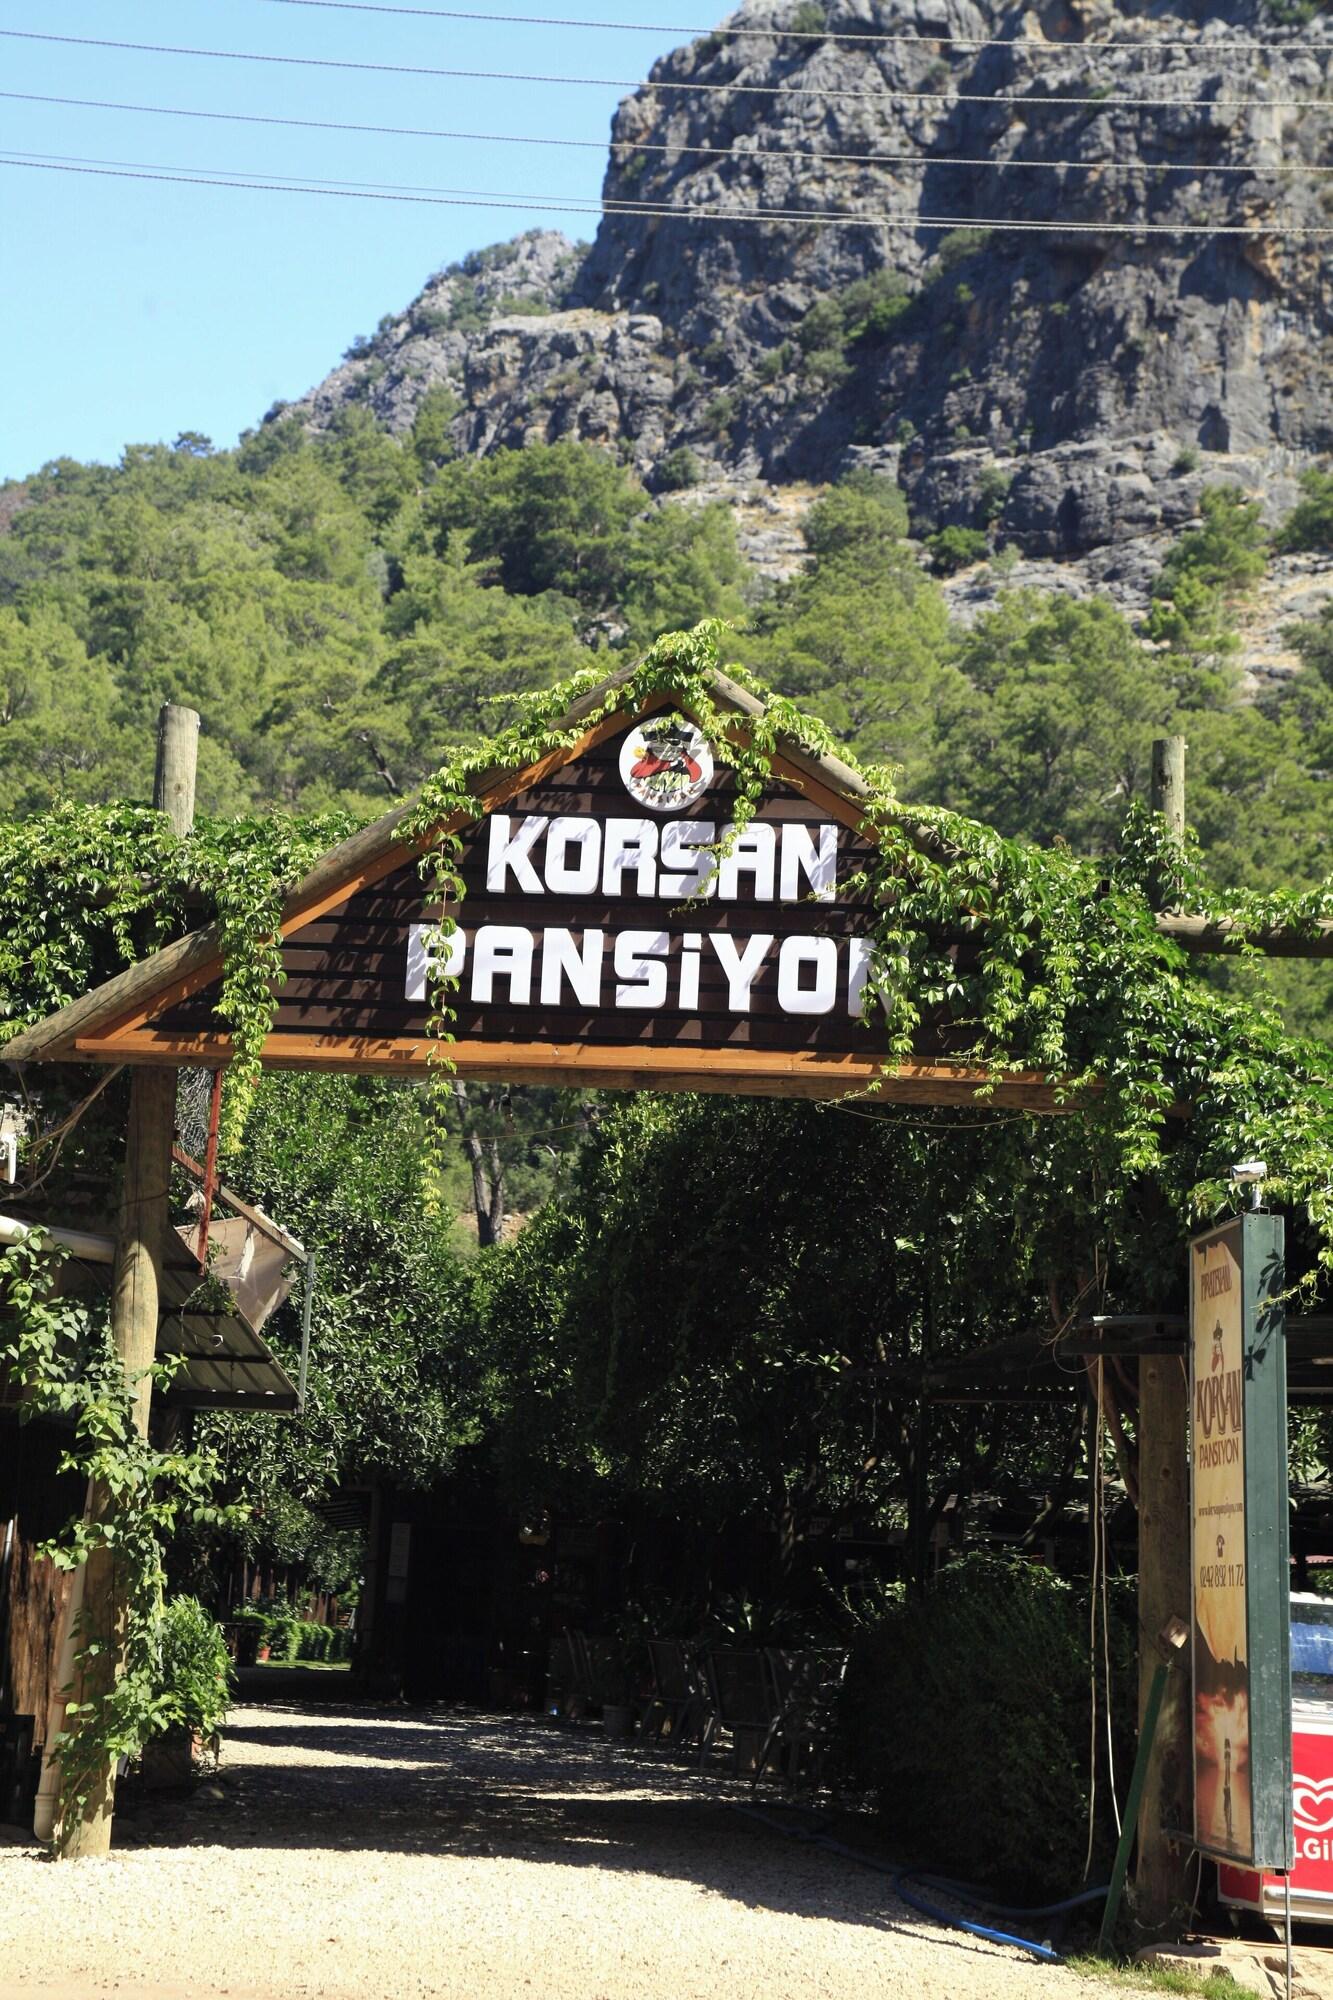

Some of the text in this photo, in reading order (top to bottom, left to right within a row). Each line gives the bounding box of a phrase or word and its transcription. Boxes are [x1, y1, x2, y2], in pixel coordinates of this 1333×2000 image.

[486, 815, 839, 903] KORSAN
[1197, 1369, 1241, 1439] KORSAN
[1228, 1564, 1234, 1587] 11
[1235, 1563, 1244, 1587] 72
[1293, 1837, 1333, 1861] LGi
